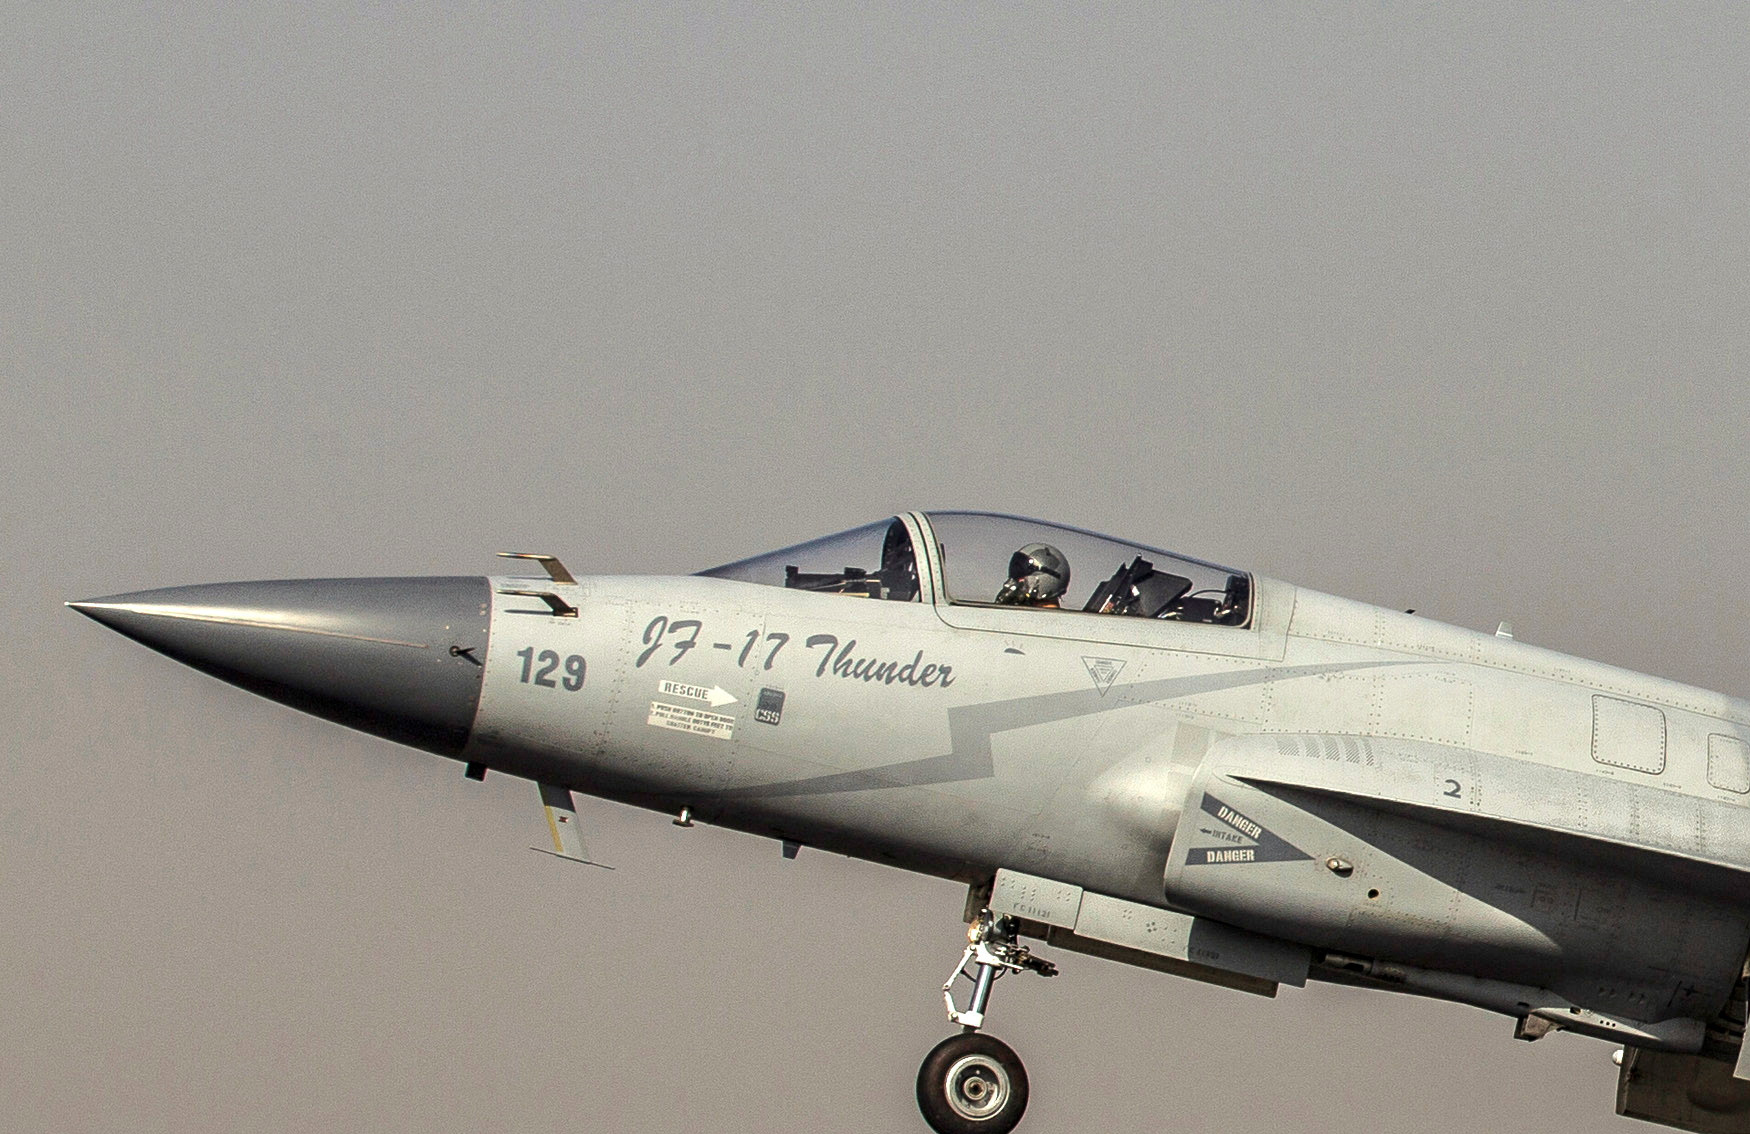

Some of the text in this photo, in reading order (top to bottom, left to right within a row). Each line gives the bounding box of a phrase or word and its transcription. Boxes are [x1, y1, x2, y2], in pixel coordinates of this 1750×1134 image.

[517, 646, 587, 692] 129
[805, 634, 957, 688] Thunder
[664, 682, 709, 700] RESCUE
[1443, 779, 1461, 799] 2
[1217, 806, 1262, 839] DANGER
[1212, 829, 1243, 844] INTAKE
[1206, 849, 1255, 863] DANGER
